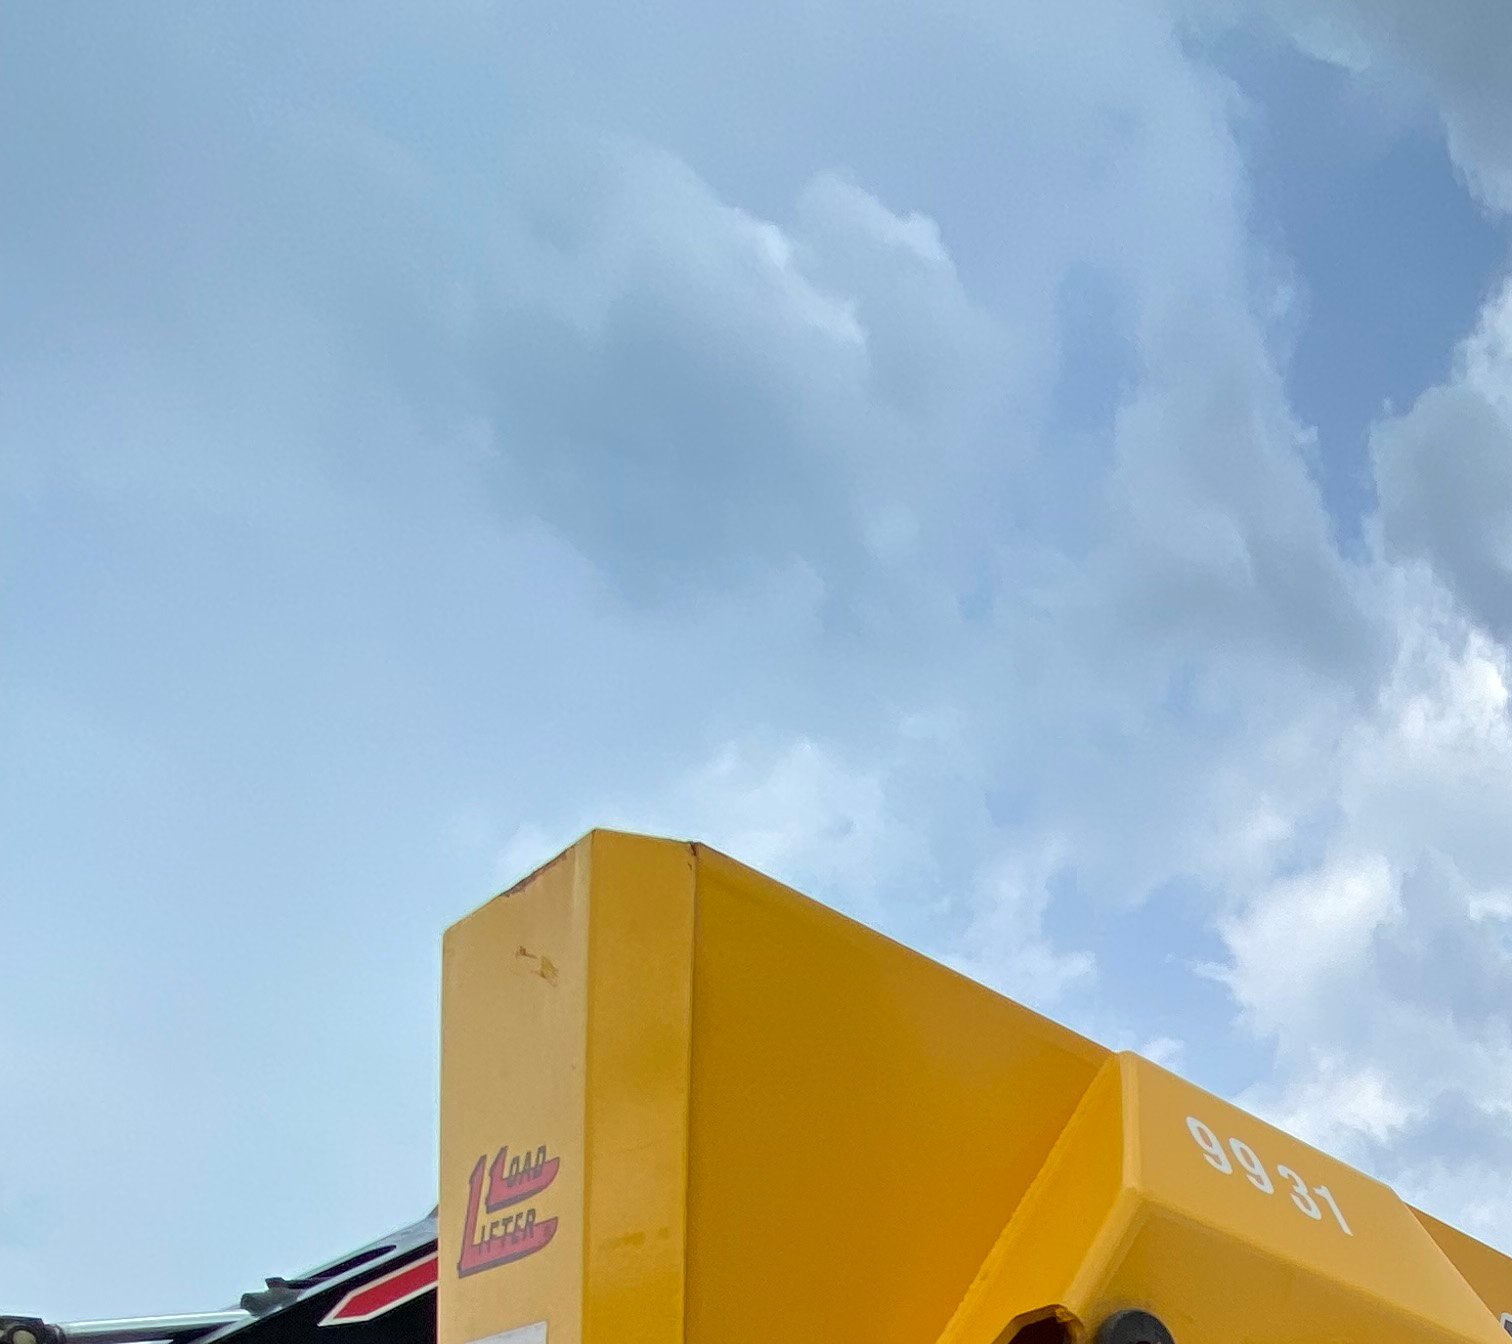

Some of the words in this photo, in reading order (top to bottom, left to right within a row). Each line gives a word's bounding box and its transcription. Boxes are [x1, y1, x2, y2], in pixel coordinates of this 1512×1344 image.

[457, 1154, 559, 1279] LIFTER
[485, 1145, 560, 1214] LOAD
[1186, 1116, 1353, 1237] 9931
